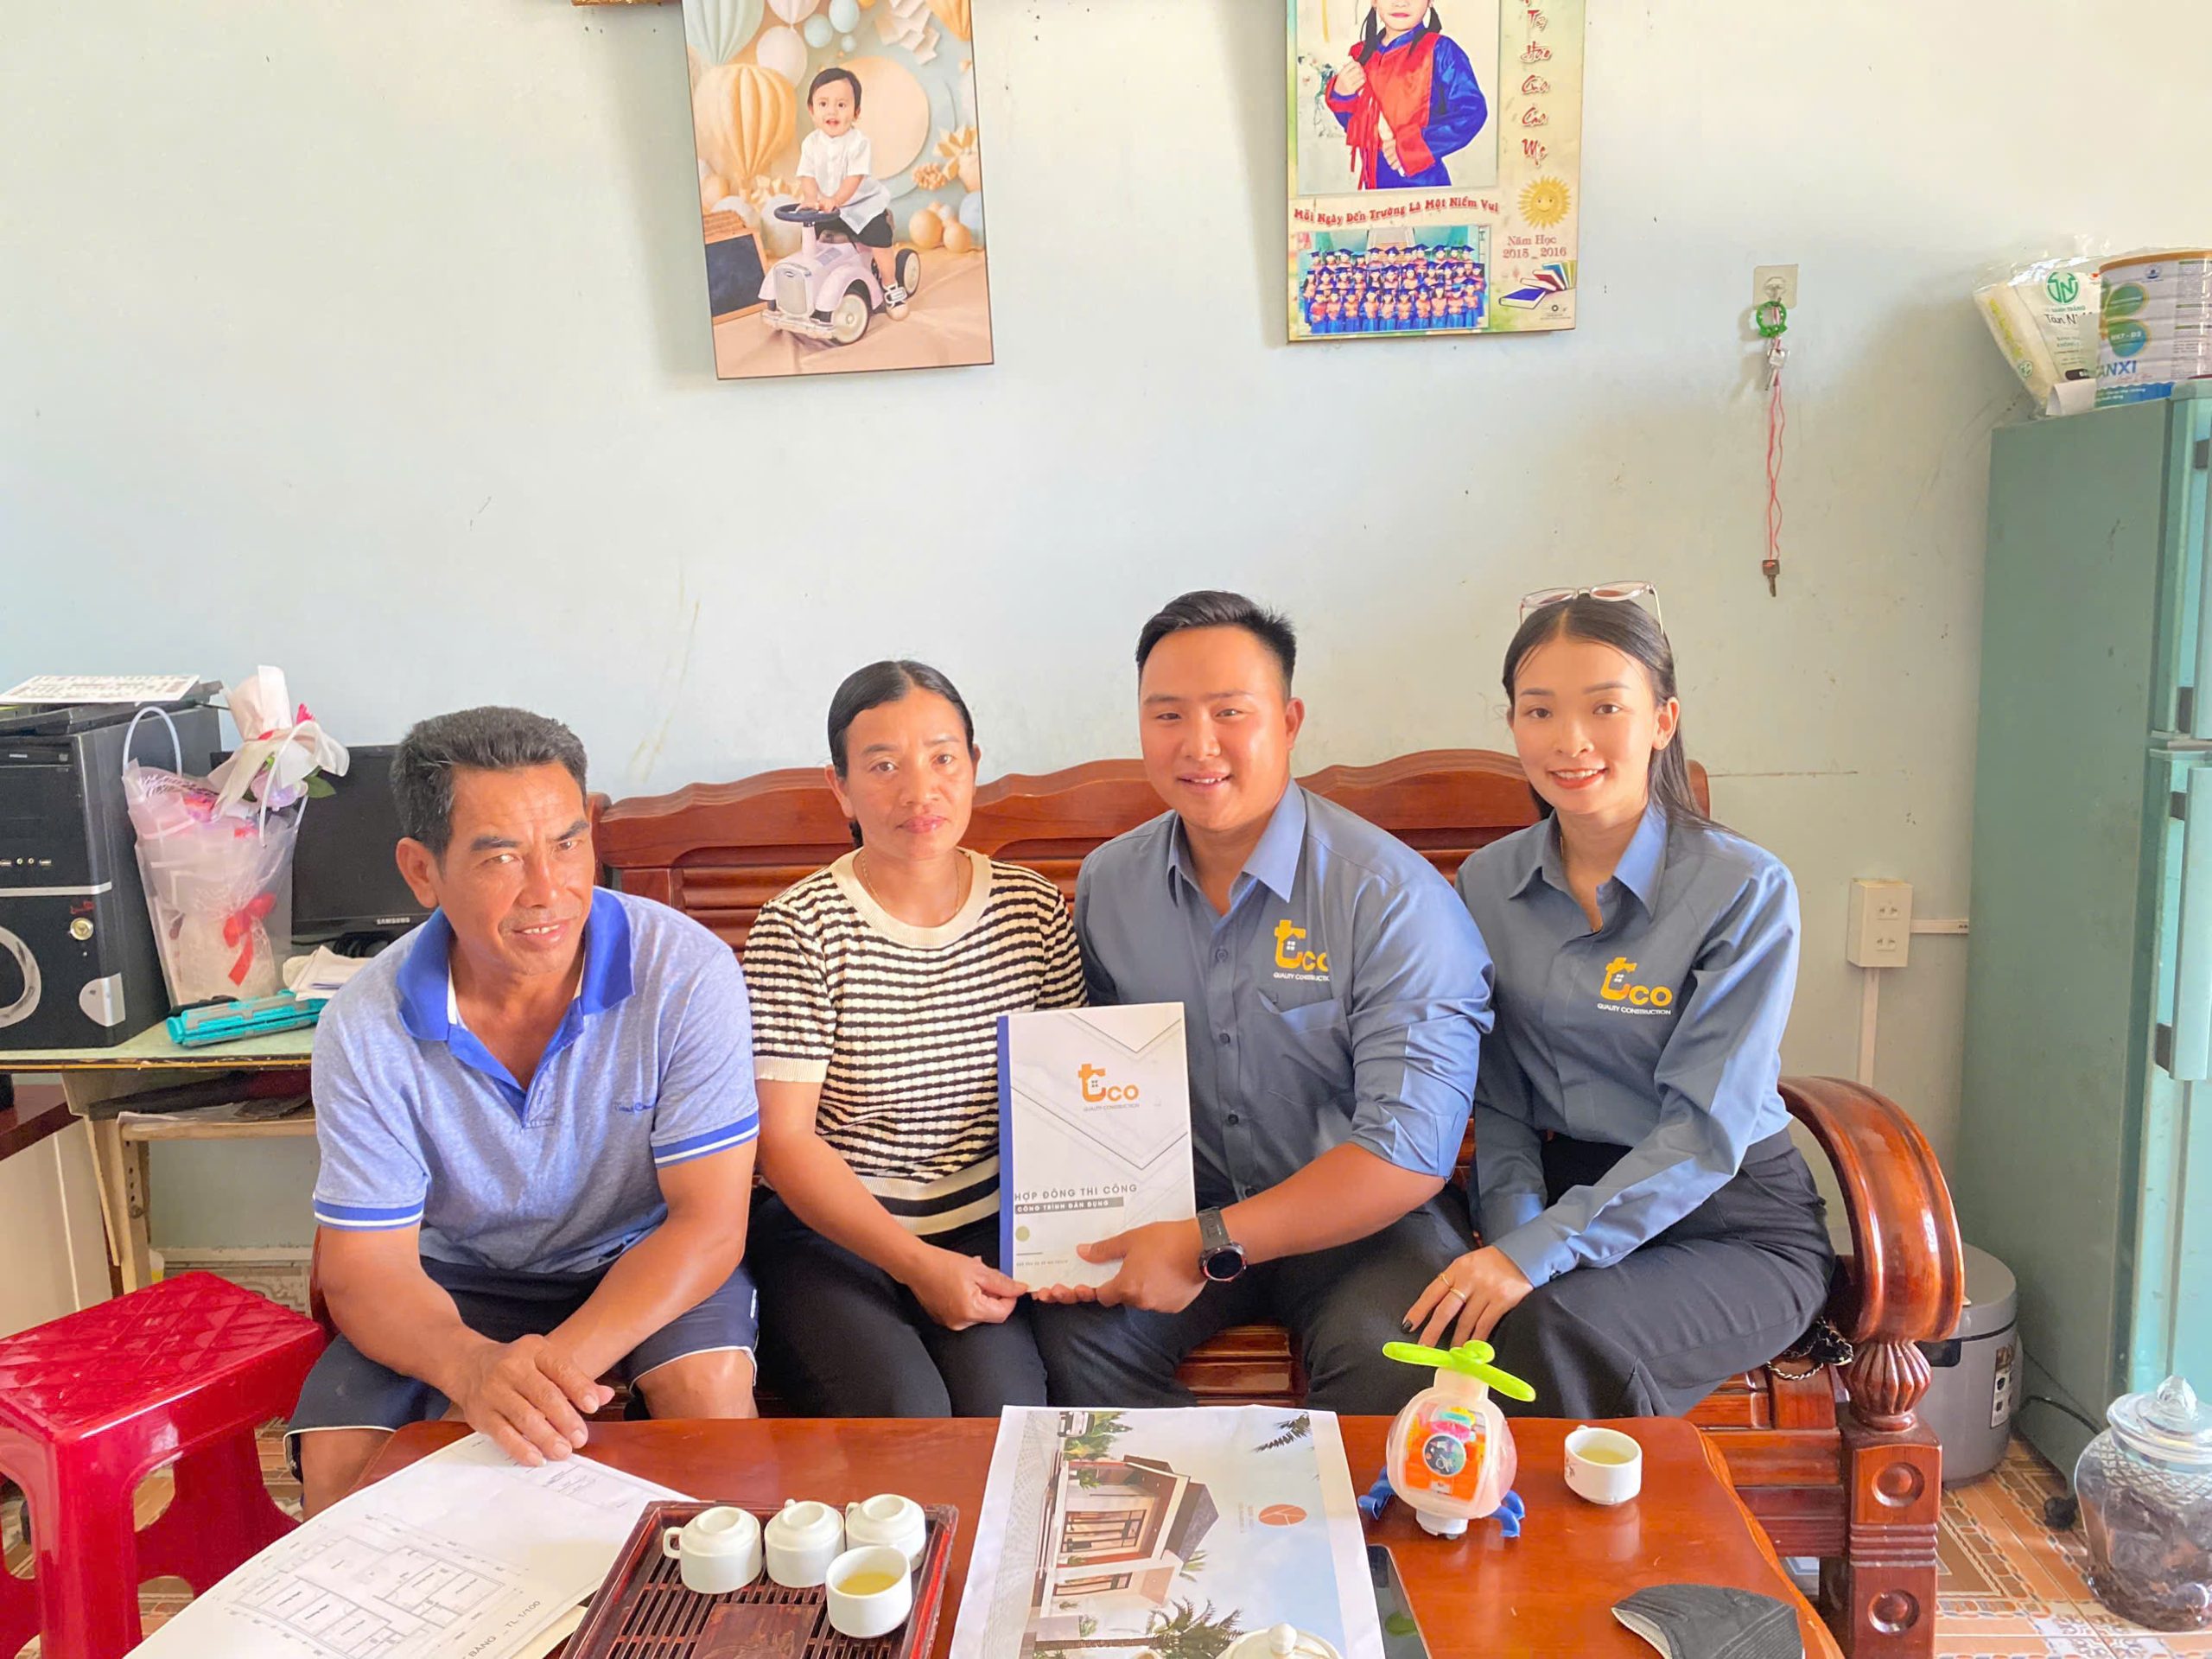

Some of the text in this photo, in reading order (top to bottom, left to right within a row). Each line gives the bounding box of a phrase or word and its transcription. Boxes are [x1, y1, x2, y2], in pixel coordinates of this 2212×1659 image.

[1317, 213, 1343, 226] Ngày
[1425, 199, 1446, 212] Một
[1480, 200, 1498, 212] Vui
[1535, 235, 1556, 245] Học
[1503, 249, 1529, 258] 2015
[1540, 247, 1567, 257] 2016
[1597, 1003, 1671, 1015] QUALITY CONSTRUCTION
[1014, 1192, 1037, 1202] HỢP
[1080, 1187, 1097, 1196] THI
[1103, 1184, 1137, 1193] CÔNG
[518, 1600, 541, 1618] 1/100
